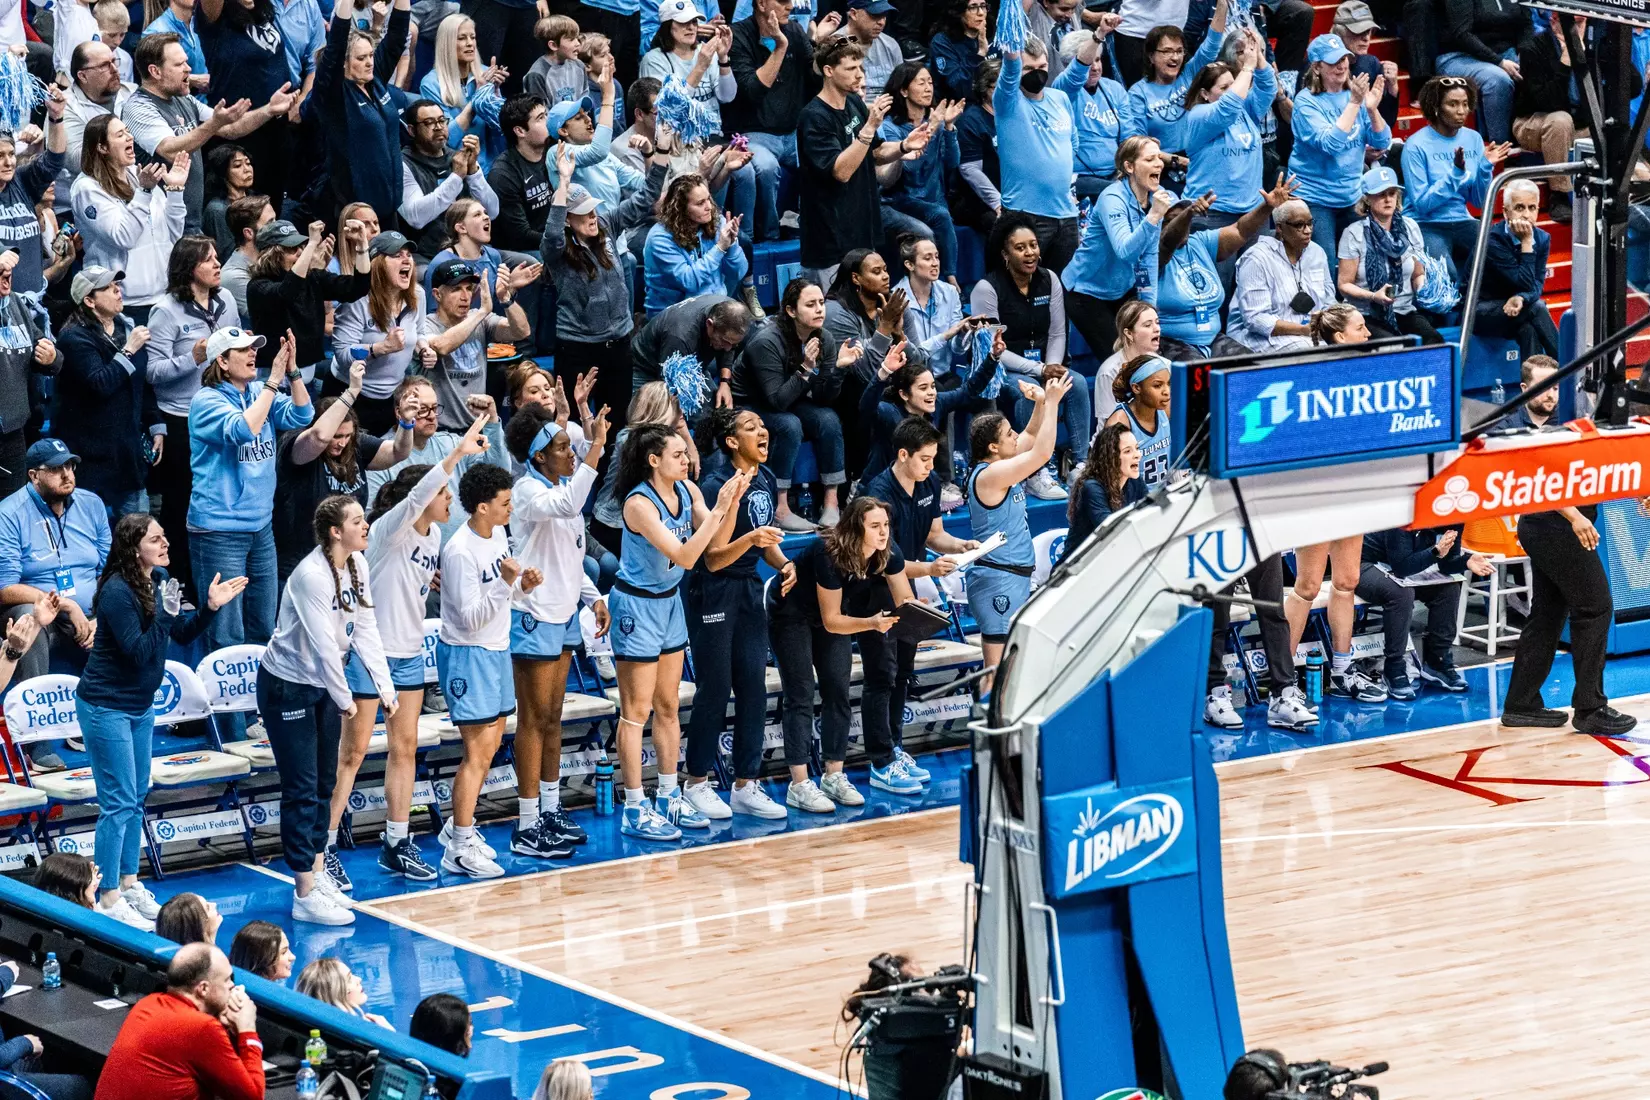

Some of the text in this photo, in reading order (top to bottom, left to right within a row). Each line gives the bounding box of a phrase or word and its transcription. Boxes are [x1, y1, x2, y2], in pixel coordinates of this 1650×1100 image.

[1328, 38, 1340, 49] C
[1379, 170, 1389, 181] C
[1297, 375, 1436, 423] INTRUST
[1389, 410, 1441, 433] Bank.
[53, 440, 66, 452] C
[1187, 526, 1249, 582] KU
[1355, 641, 1382, 653] Capitol
[217, 679, 258, 698] Fede
[26, 707, 77, 727] Feder
[915, 701, 970, 718] Capitol Federal
[412, 789, 430, 798] eral
[176, 818, 240, 834] Capitol Federal
[1065, 804, 1174, 892] LIBMAN
[964, 1066, 1022, 1092] DAKTRONICS
